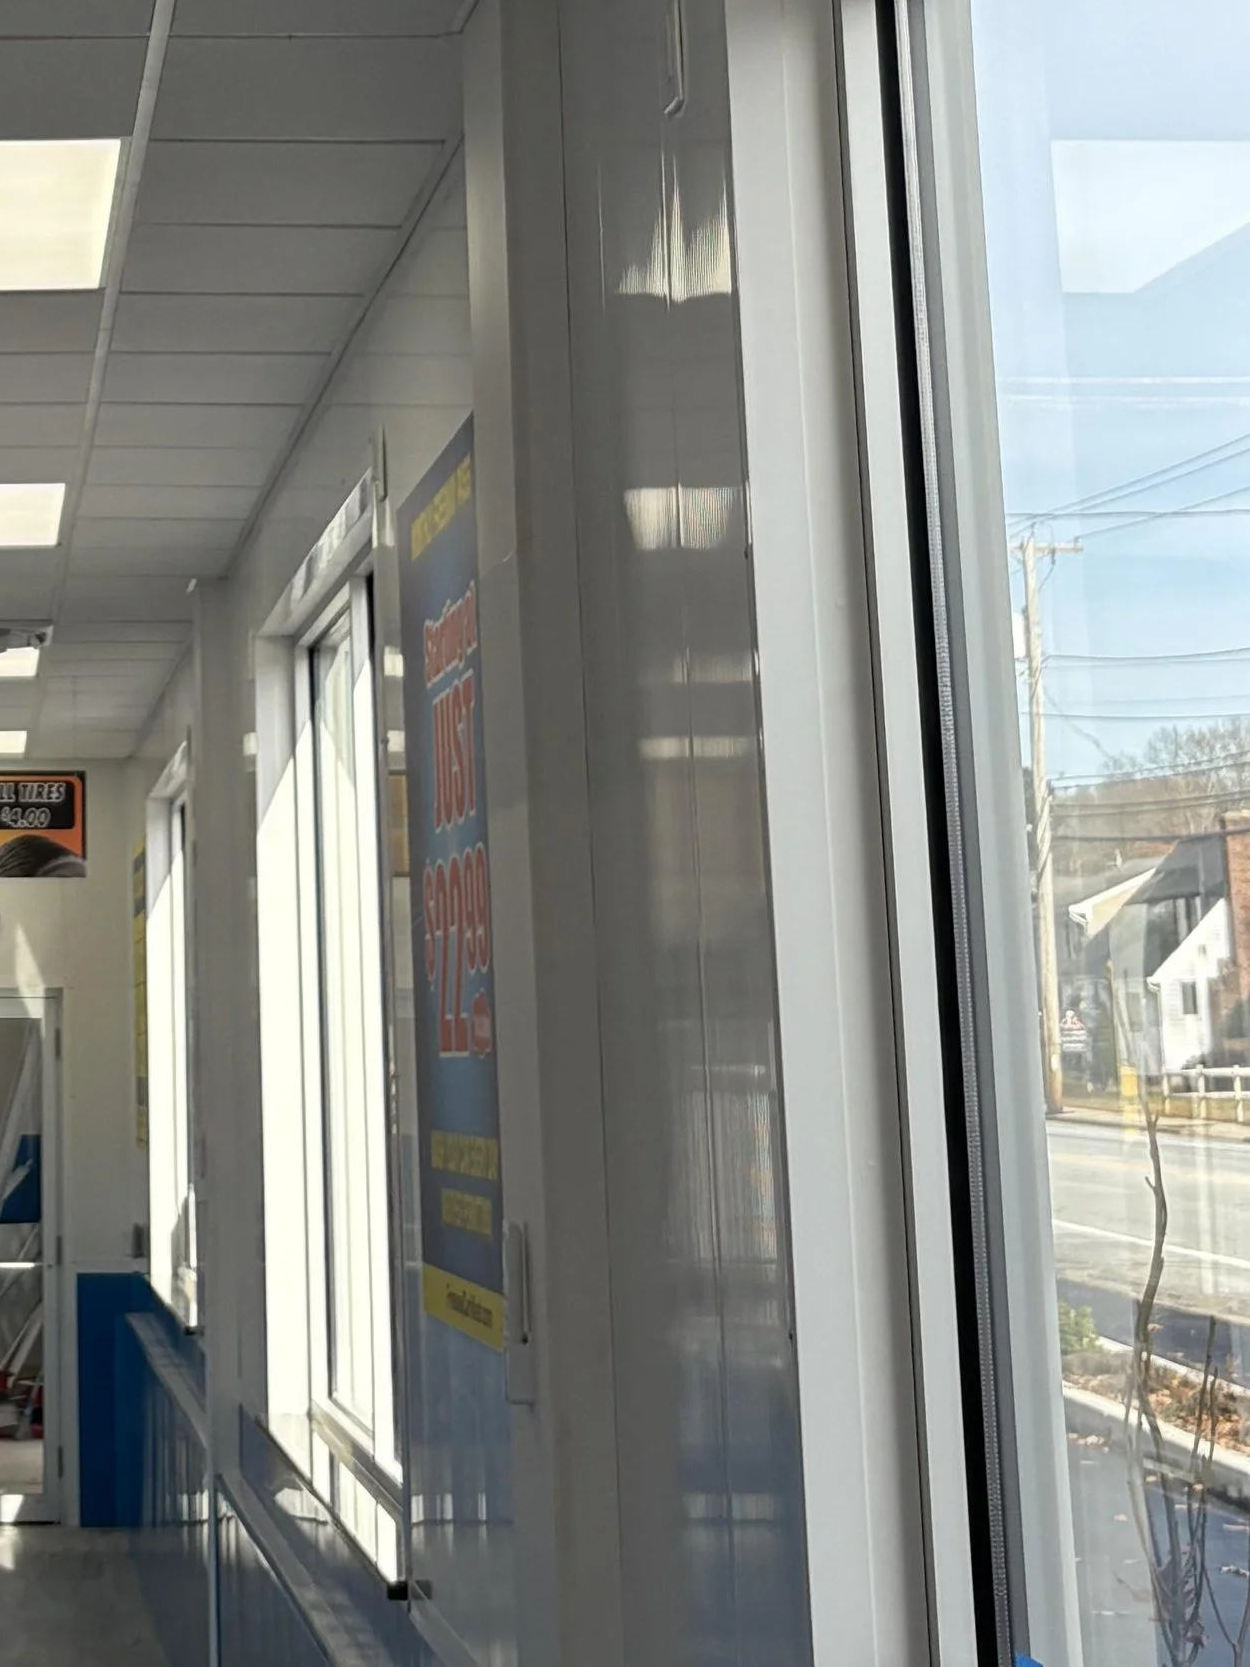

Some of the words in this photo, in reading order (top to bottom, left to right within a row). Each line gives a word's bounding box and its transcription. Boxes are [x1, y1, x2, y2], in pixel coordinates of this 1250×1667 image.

[432, 668, 476, 833] JUST
[19, 782, 66, 803] TIRES
[0, 807, 50, 828] $4.00
